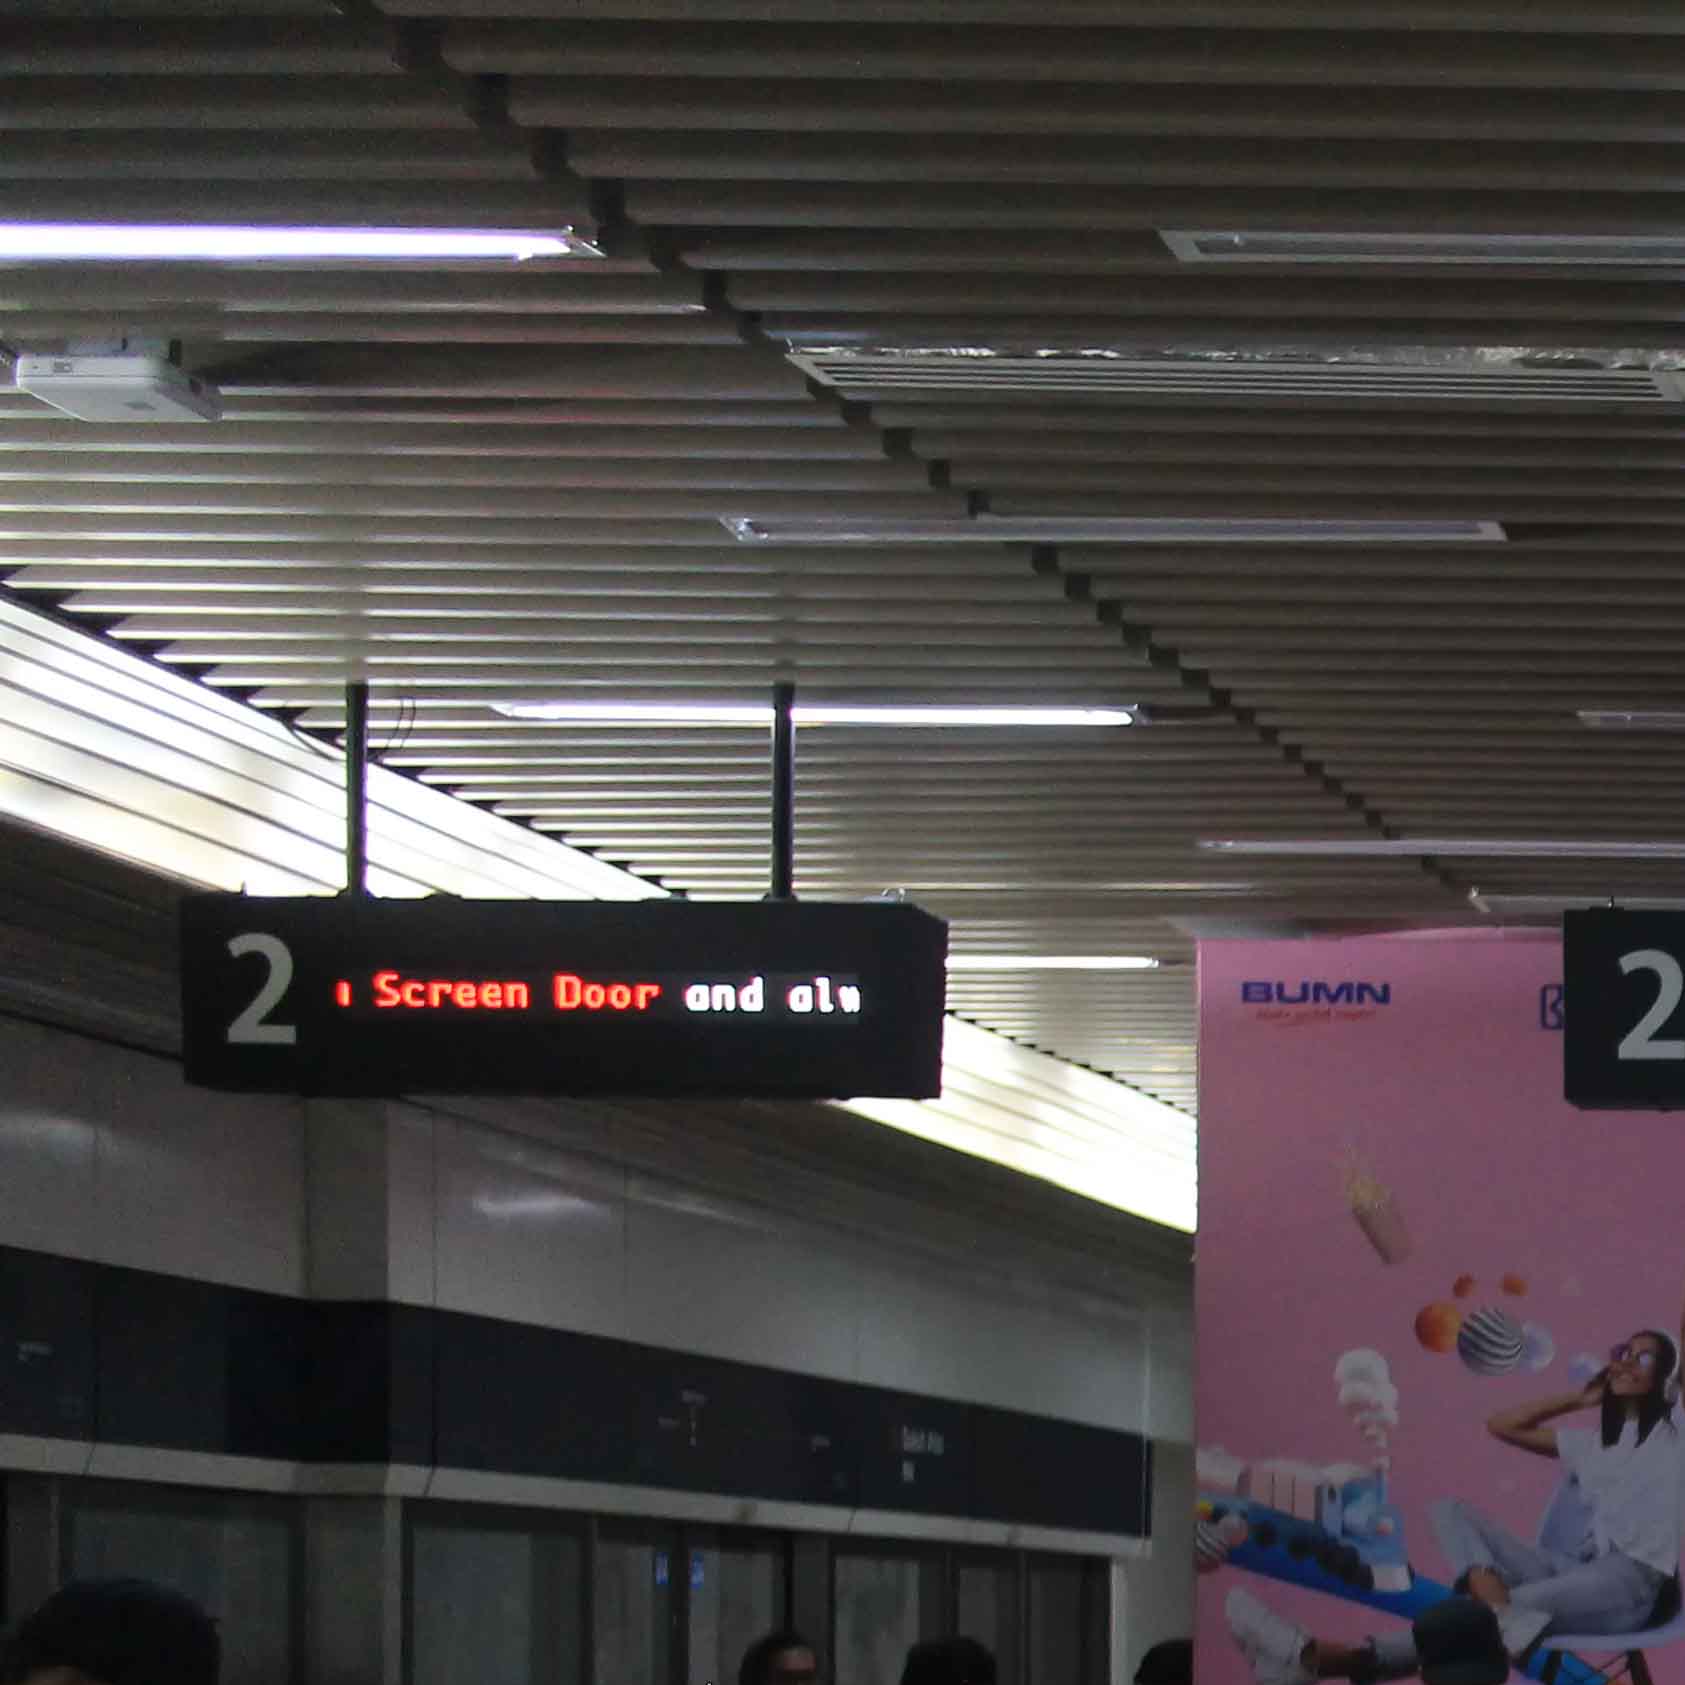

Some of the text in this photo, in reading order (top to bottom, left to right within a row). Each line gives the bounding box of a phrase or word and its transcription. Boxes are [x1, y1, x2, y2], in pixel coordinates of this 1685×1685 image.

[226, 932, 297, 1044] 2
[372, 969, 529, 1009] Screen
[553, 973, 662, 1011] Door
[684, 975, 765, 1013] and
[1241, 980, 1391, 1004] BUMN
